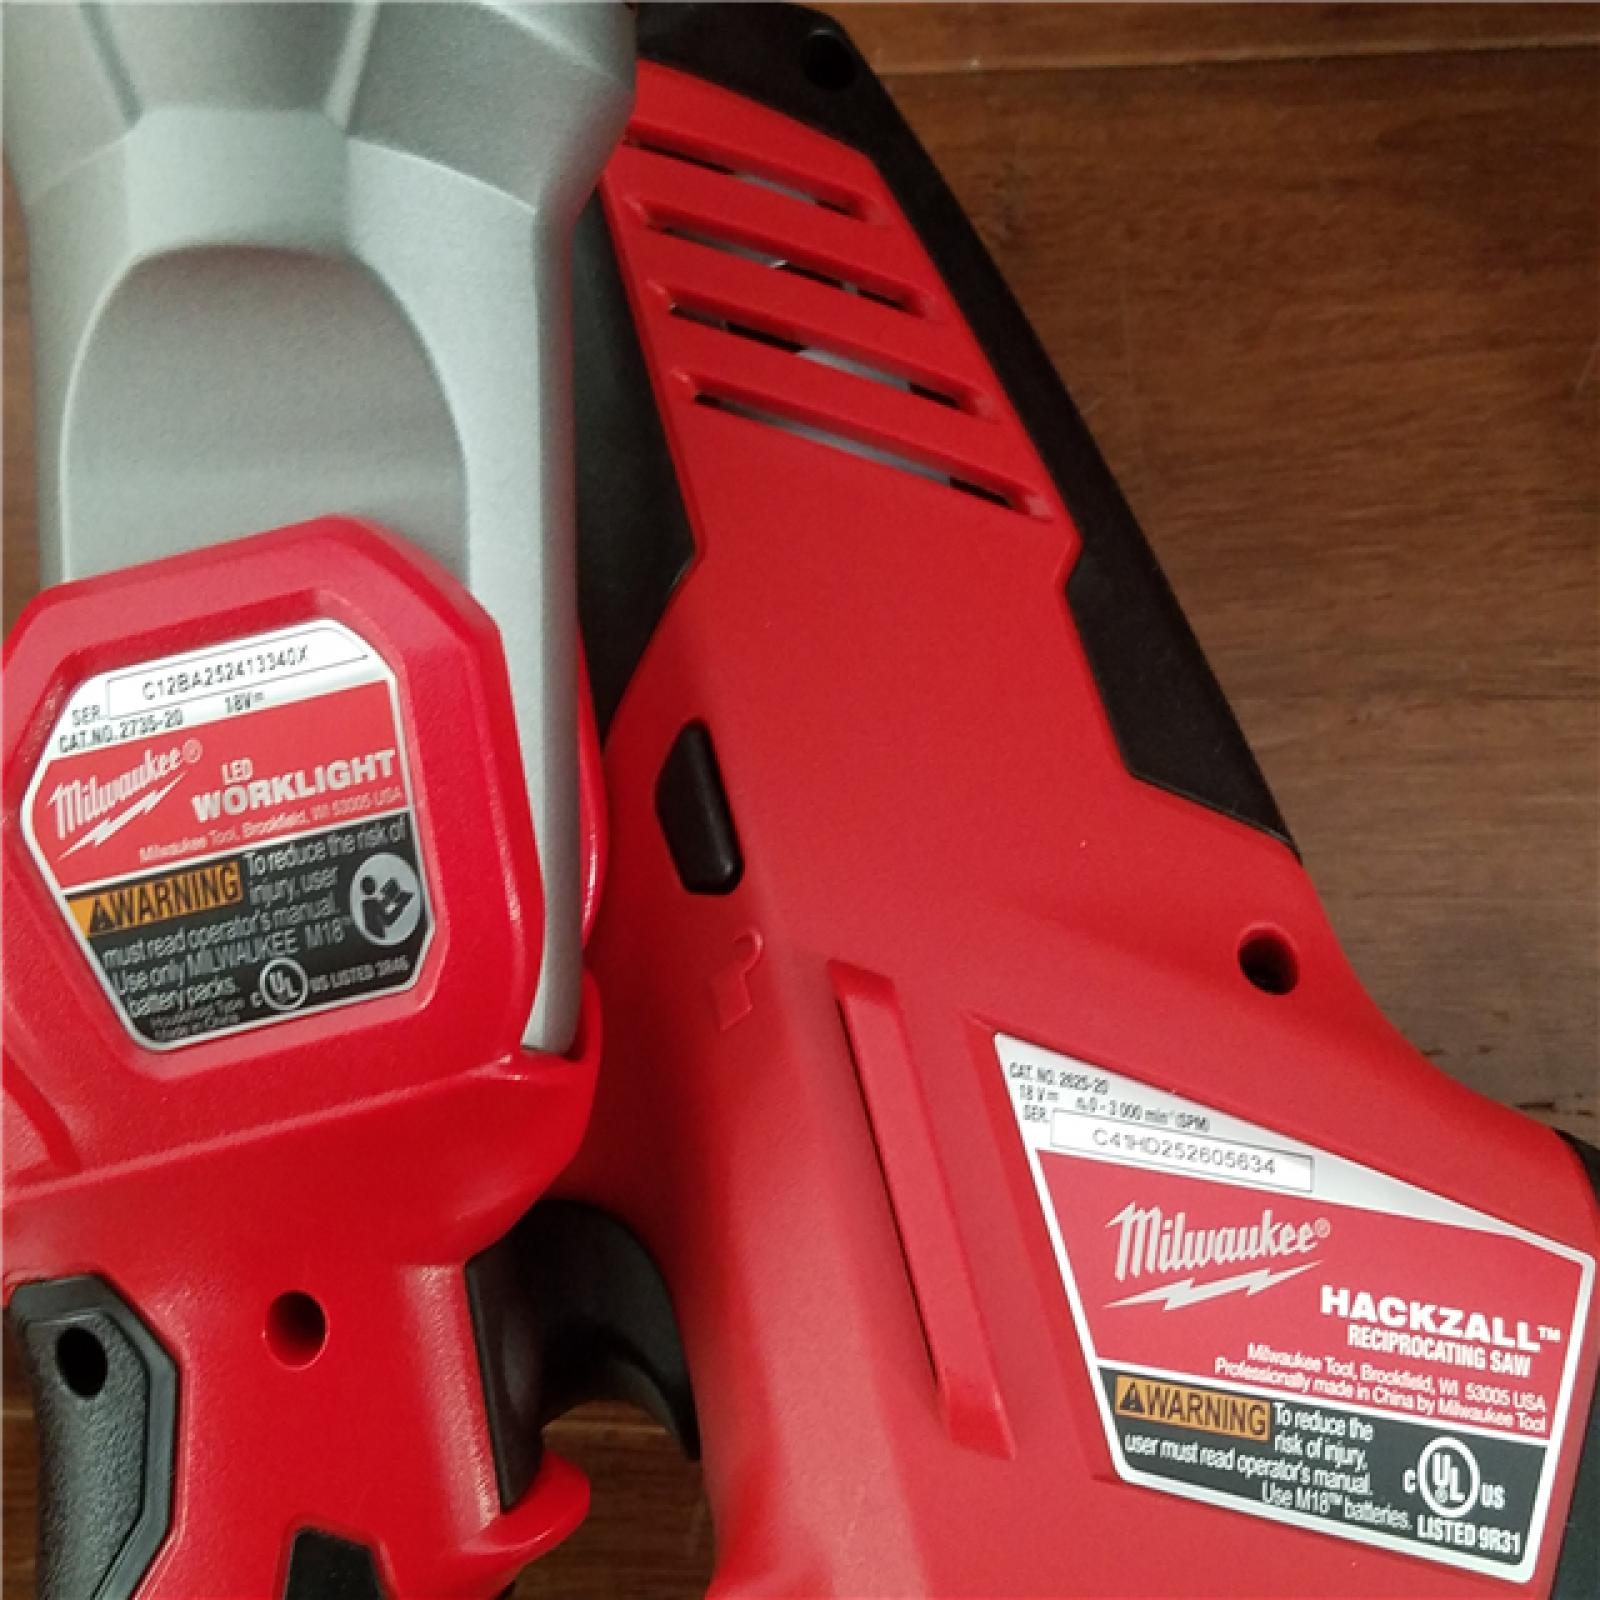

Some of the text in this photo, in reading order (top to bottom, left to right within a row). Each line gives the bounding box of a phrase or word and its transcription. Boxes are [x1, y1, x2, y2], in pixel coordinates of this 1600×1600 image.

[193, 748, 396, 823] WORKLIGHT
[222, 758, 254, 785] LED
[243, 813, 407, 876] To reduce the risk of
[109, 862, 240, 927] WARNING
[302, 866, 339, 893] user
[103, 938, 146, 969] must
[147, 927, 186, 960] read
[112, 968, 149, 996] Use
[150, 957, 187, 988] only
[1247, 1341, 1323, 1372] Milwaukee
[1438, 1376, 1460, 1397] WI
[1464, 1381, 1511, 1407] 53005
[1512, 1390, 1547, 1414] USA
[1347, 1323, 1532, 1379] RECIPROCATING SAW
[1145, 1383, 1266, 1437] WARNING
[1214, 1355, 1547, 1433] Professionally made in China by Milwaukee Tool
[1272, 1400, 1375, 1443] To reduce the
[1274, 1429, 1304, 1456] risk
[1305, 1436, 1324, 1460] of
[1124, 1433, 1160, 1457] user
[1160, 1438, 1199, 1464] must
[1199, 1446, 1236, 1471] read
[1236, 1453, 1311, 1486] operator's
[1432, 1451, 1467, 1503] UL
[1480, 1482, 1506, 1511] US
[1261, 1479, 1294, 1510] Use
[1416, 1513, 1522, 1557] LISTED 9R31
